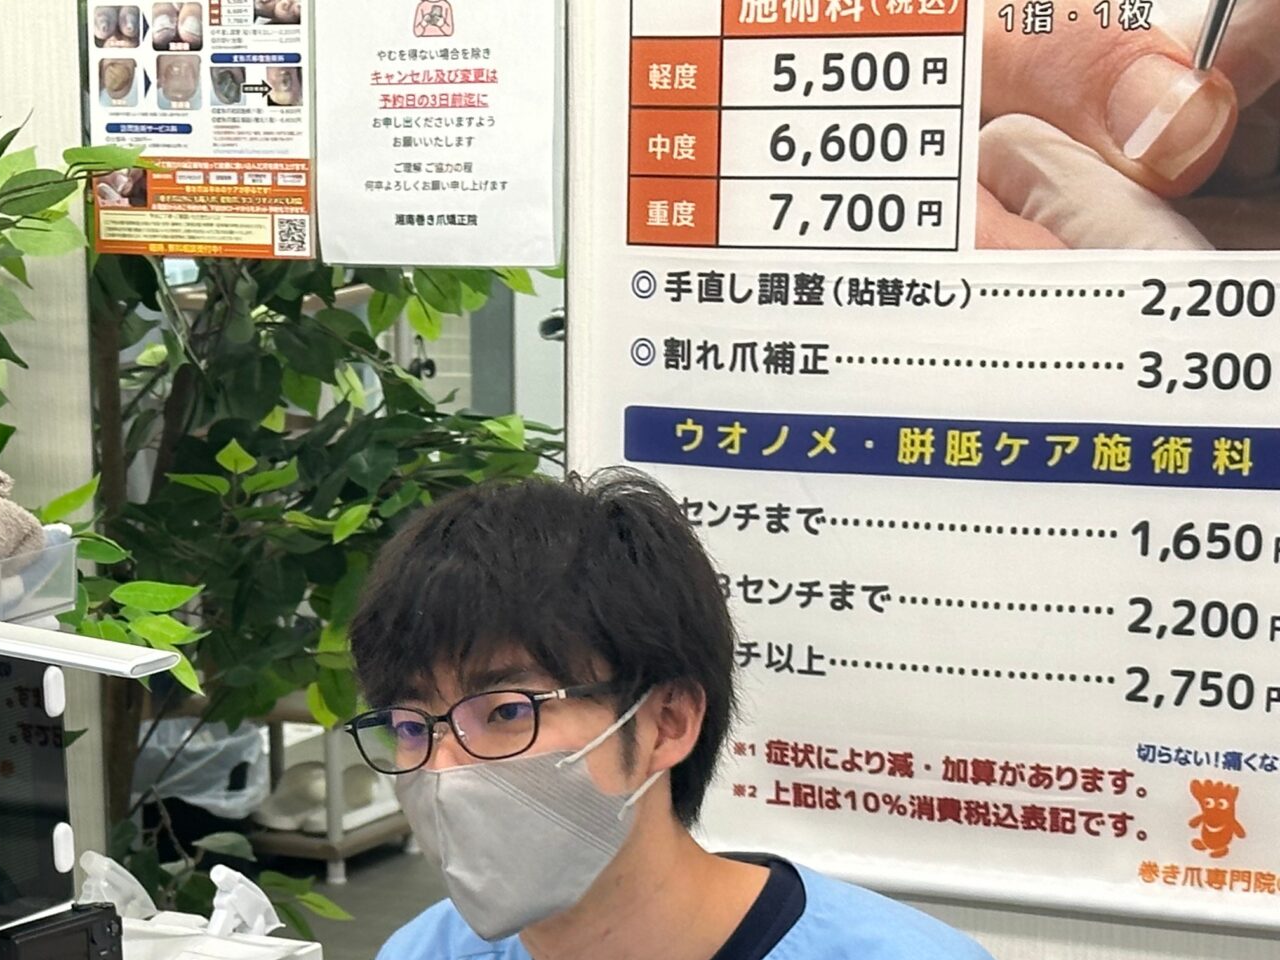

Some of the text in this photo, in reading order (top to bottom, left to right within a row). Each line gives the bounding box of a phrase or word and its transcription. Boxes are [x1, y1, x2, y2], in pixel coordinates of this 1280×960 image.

[377, 48, 491, 61] やむを得ない場合を除き
[371, 68, 498, 84] キャンセル及び変更は
[648, 63, 698, 90] 軽度
[380, 93, 489, 107] 予約日の3日前迄に
[372, 116, 495, 128] お申し出くださいますよう
[393, 136, 475, 148] お願いいたします
[647, 133, 697, 161] 中度
[364, 180, 508, 191] 何卒よろしくお願い申し上げます
[646, 200, 697, 227] 重度
[1140, 278, 1276, 321] 2,200
[662, 337, 1272, 394] 割れ爪補正 3,300
[1131, 520, 1280, 563] 1,650
[1138, 860, 1280, 895] 巻き爪専門院
